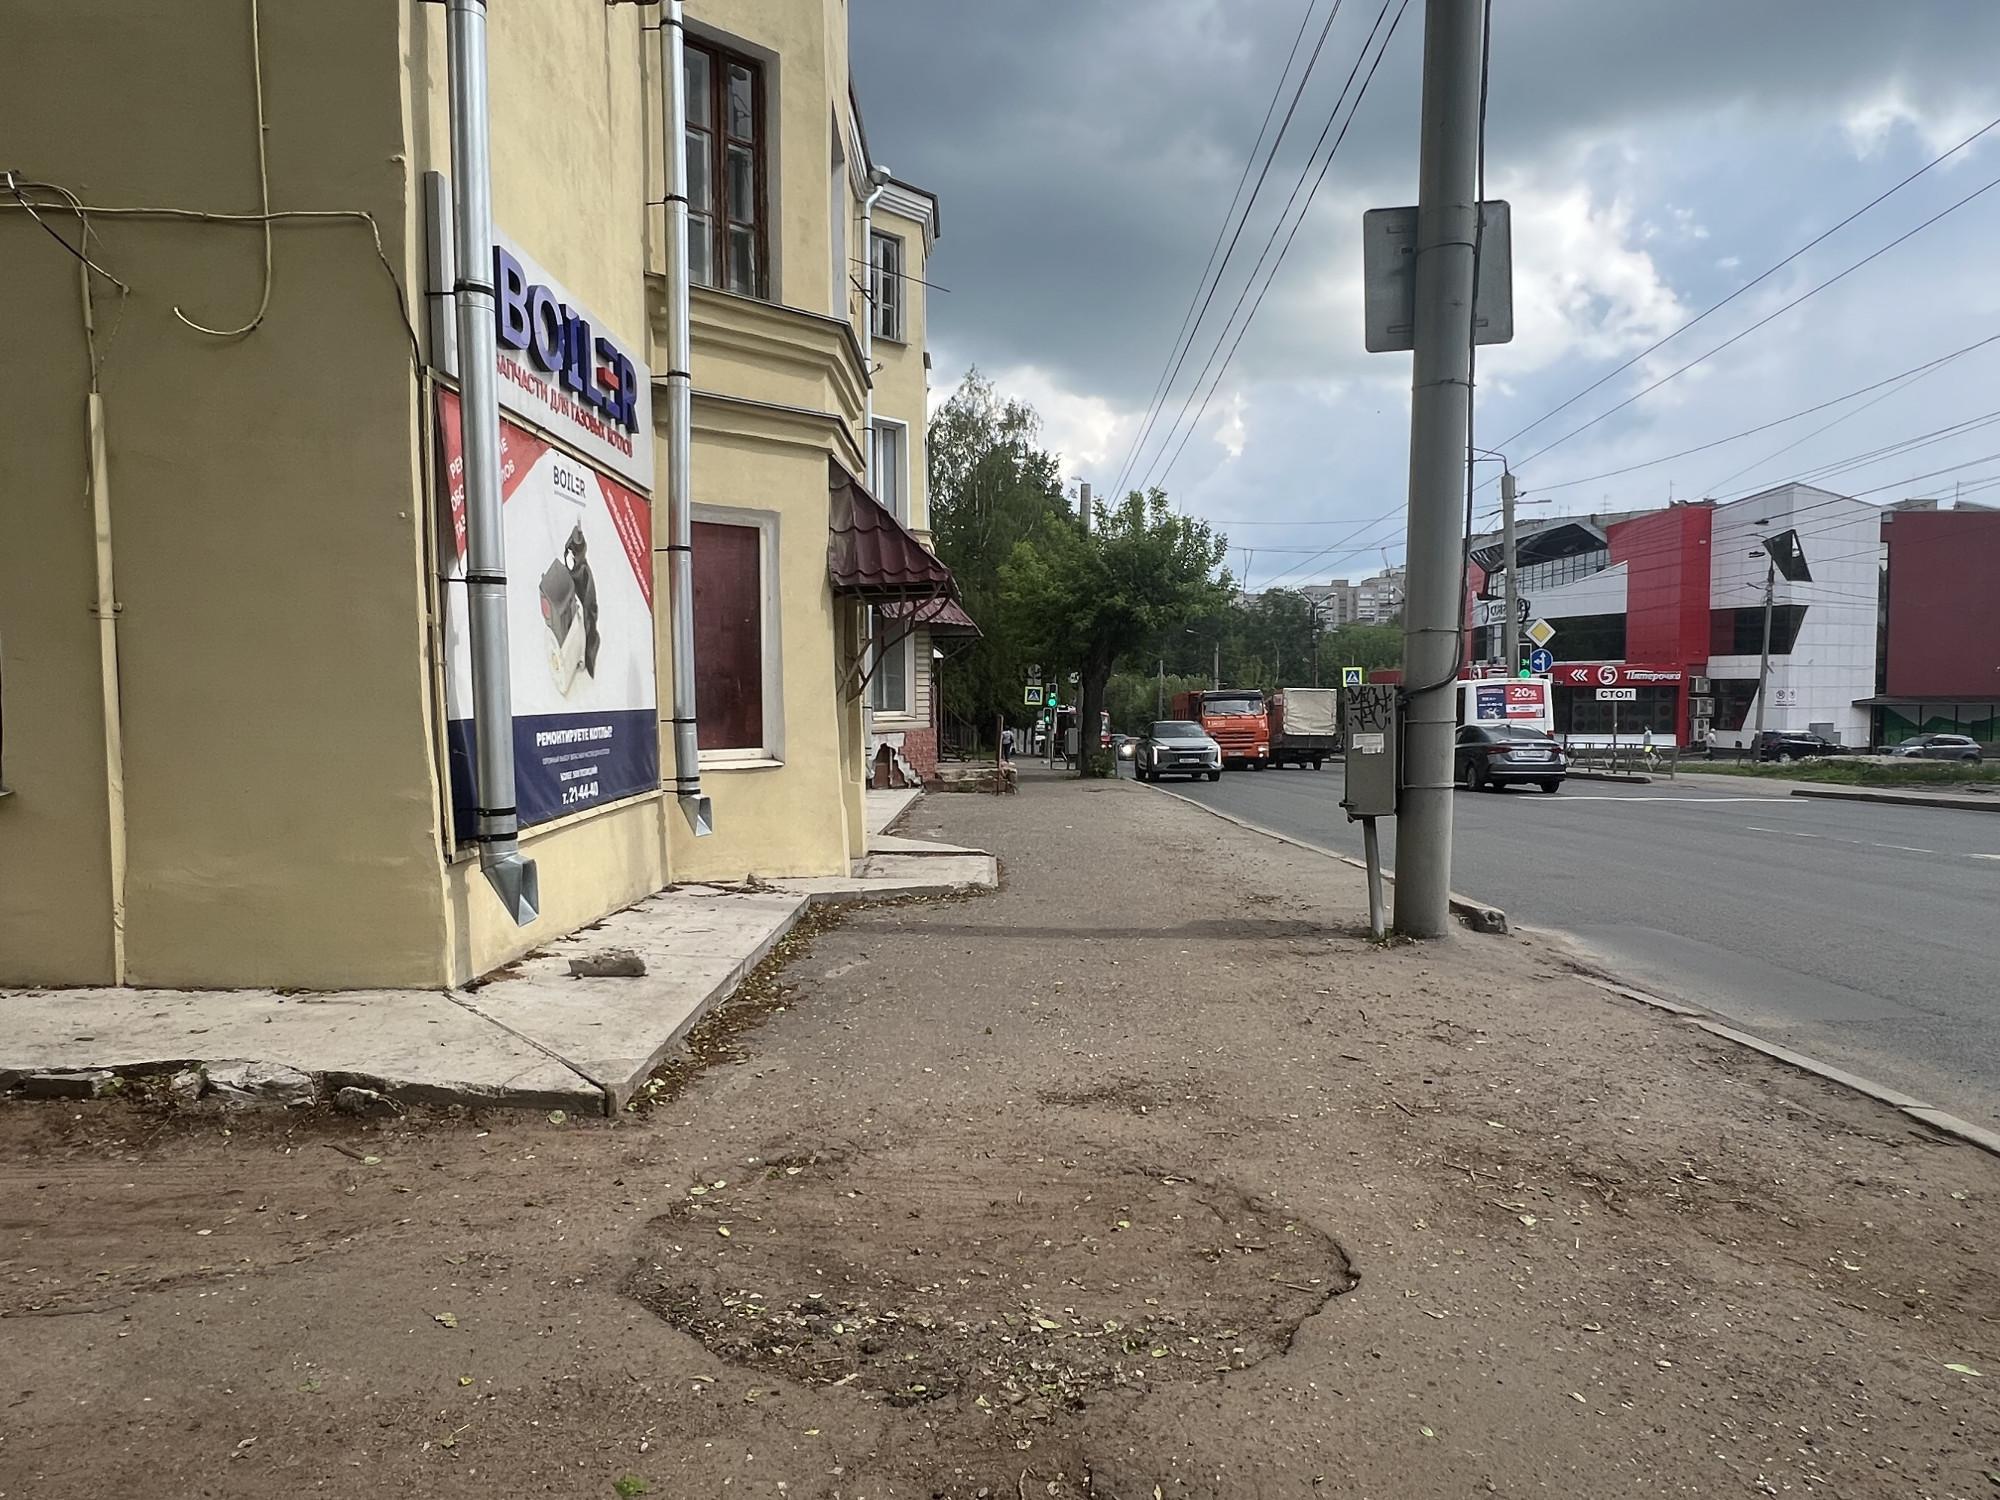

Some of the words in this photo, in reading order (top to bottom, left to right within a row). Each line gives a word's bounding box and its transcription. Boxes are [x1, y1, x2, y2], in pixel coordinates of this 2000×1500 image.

[493, 246, 639, 434] BOILER
[551, 389, 569, 416] ДЛЯ
[553, 465, 586, 499] BOILER
[1510, 687, 1537, 697] -20%
[1600, 690, 1632, 699] СТОП
[536, 729, 589, 747] РЕМОНТИРУЕТЕ
